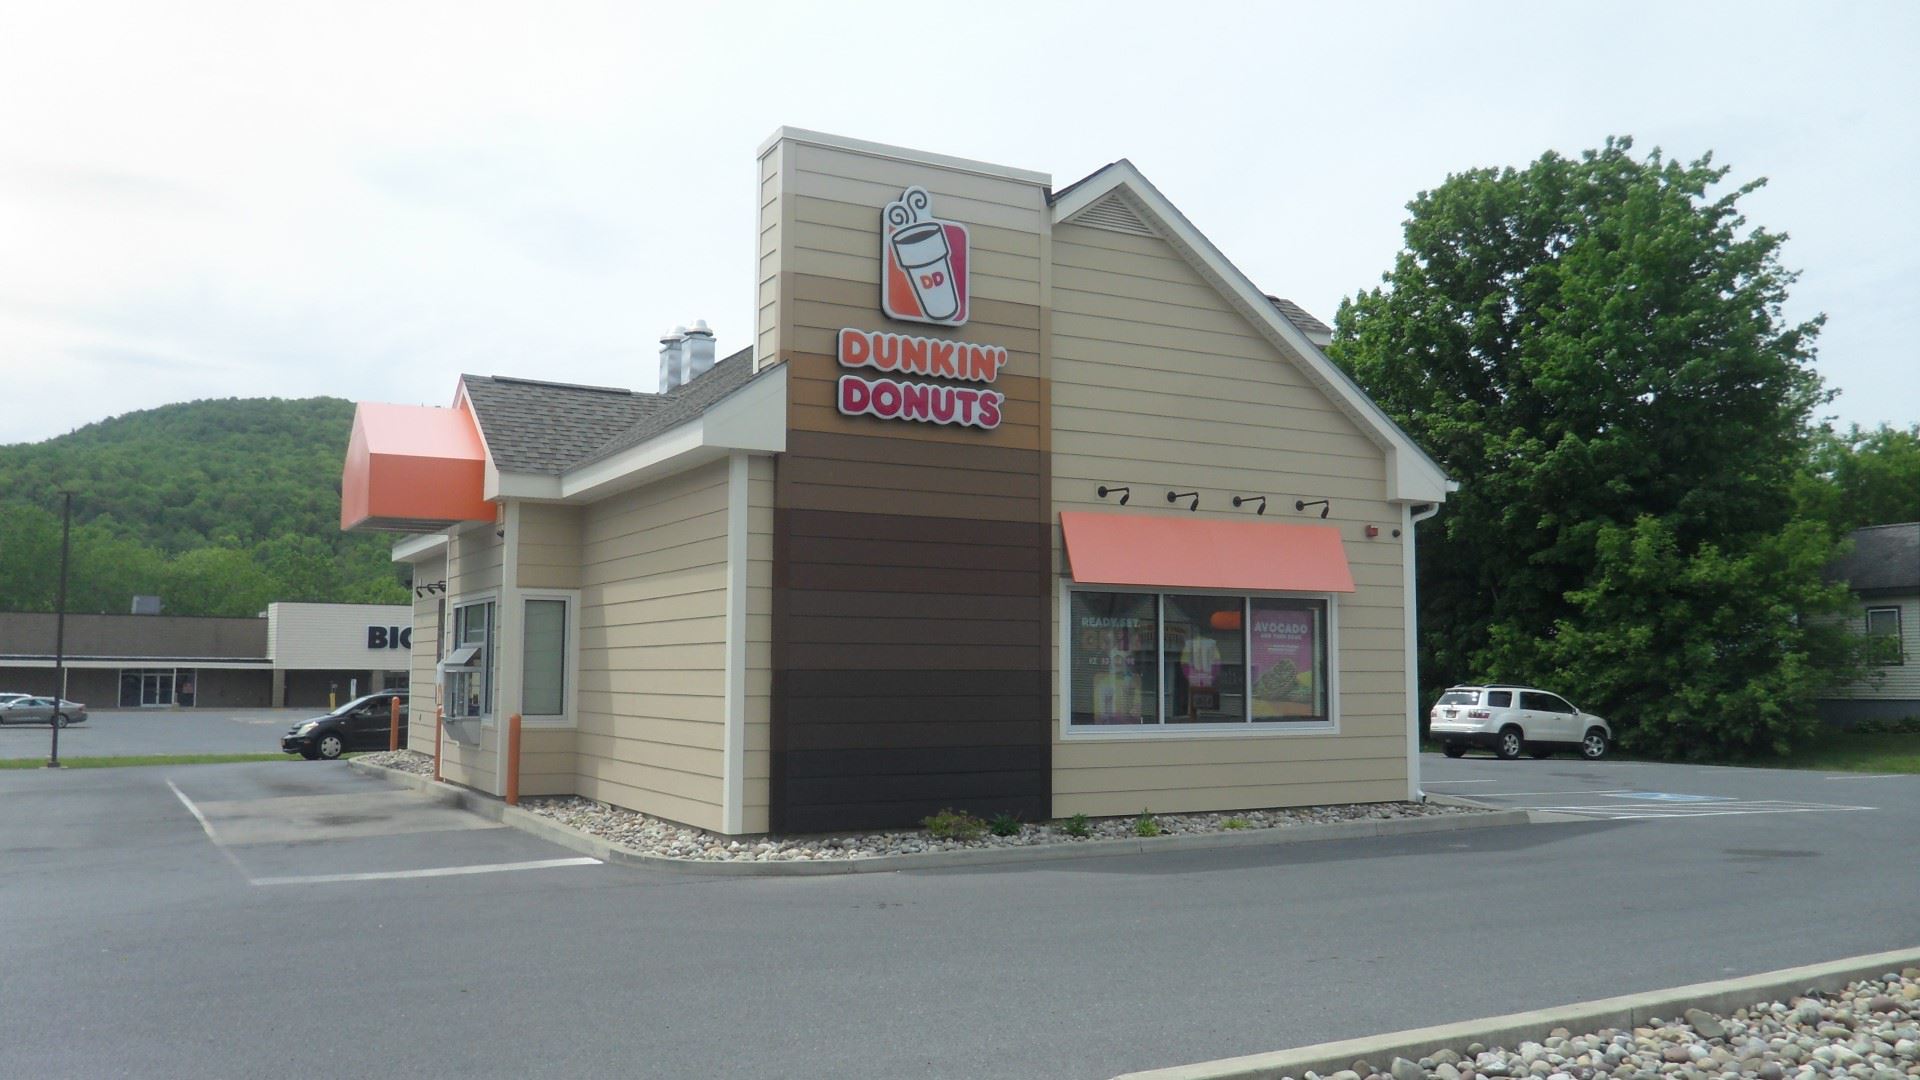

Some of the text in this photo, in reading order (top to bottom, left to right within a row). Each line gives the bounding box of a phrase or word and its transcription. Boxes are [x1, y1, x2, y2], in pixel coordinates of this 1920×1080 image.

[919, 271, 945, 289] DD
[842, 330, 1006, 381] DUNKIN'
[842, 378, 1000, 426] DONUTS
[1254, 622, 1308, 634] AVOCADO
